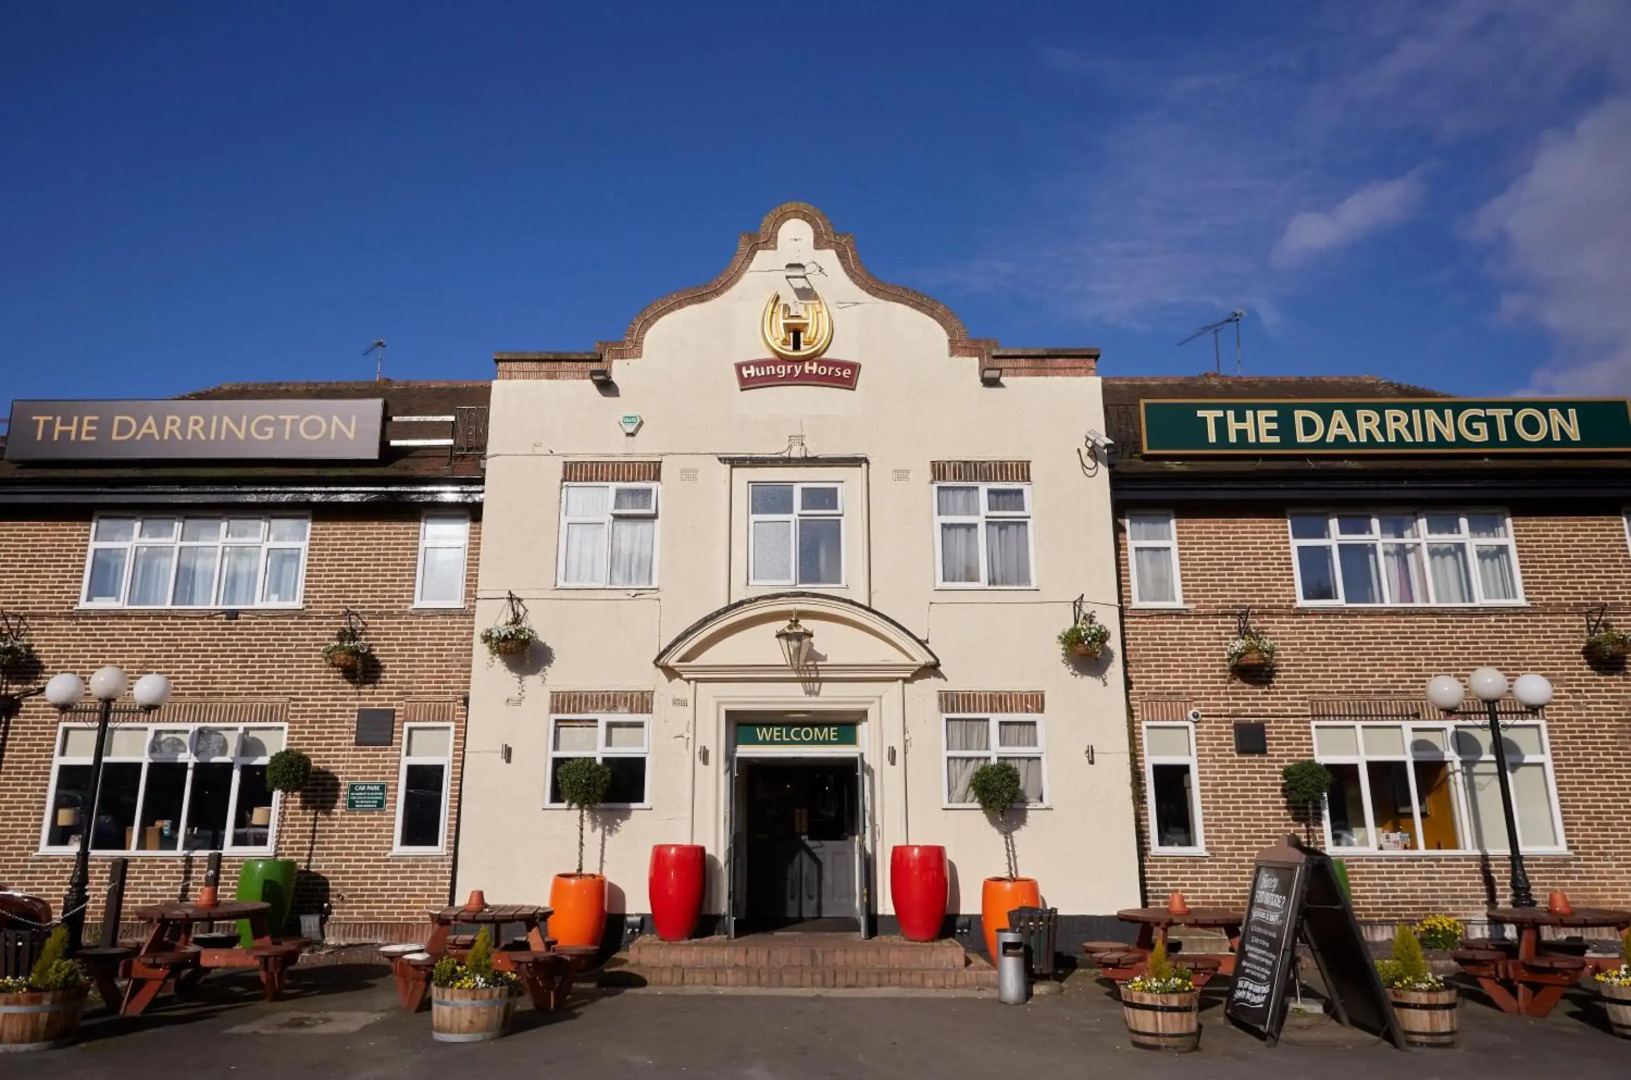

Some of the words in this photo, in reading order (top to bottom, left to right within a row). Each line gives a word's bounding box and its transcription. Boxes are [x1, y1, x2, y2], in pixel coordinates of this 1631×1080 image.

[741, 364, 802, 379] Hungry
[804, 361, 852, 378] Horse
[32, 415, 99, 441] THE
[111, 414, 357, 441] DARRINGTON
[1196, 409, 1281, 443] THE
[1293, 408, 1581, 443] DARRINGTON
[756, 726, 839, 741] WELCOME
